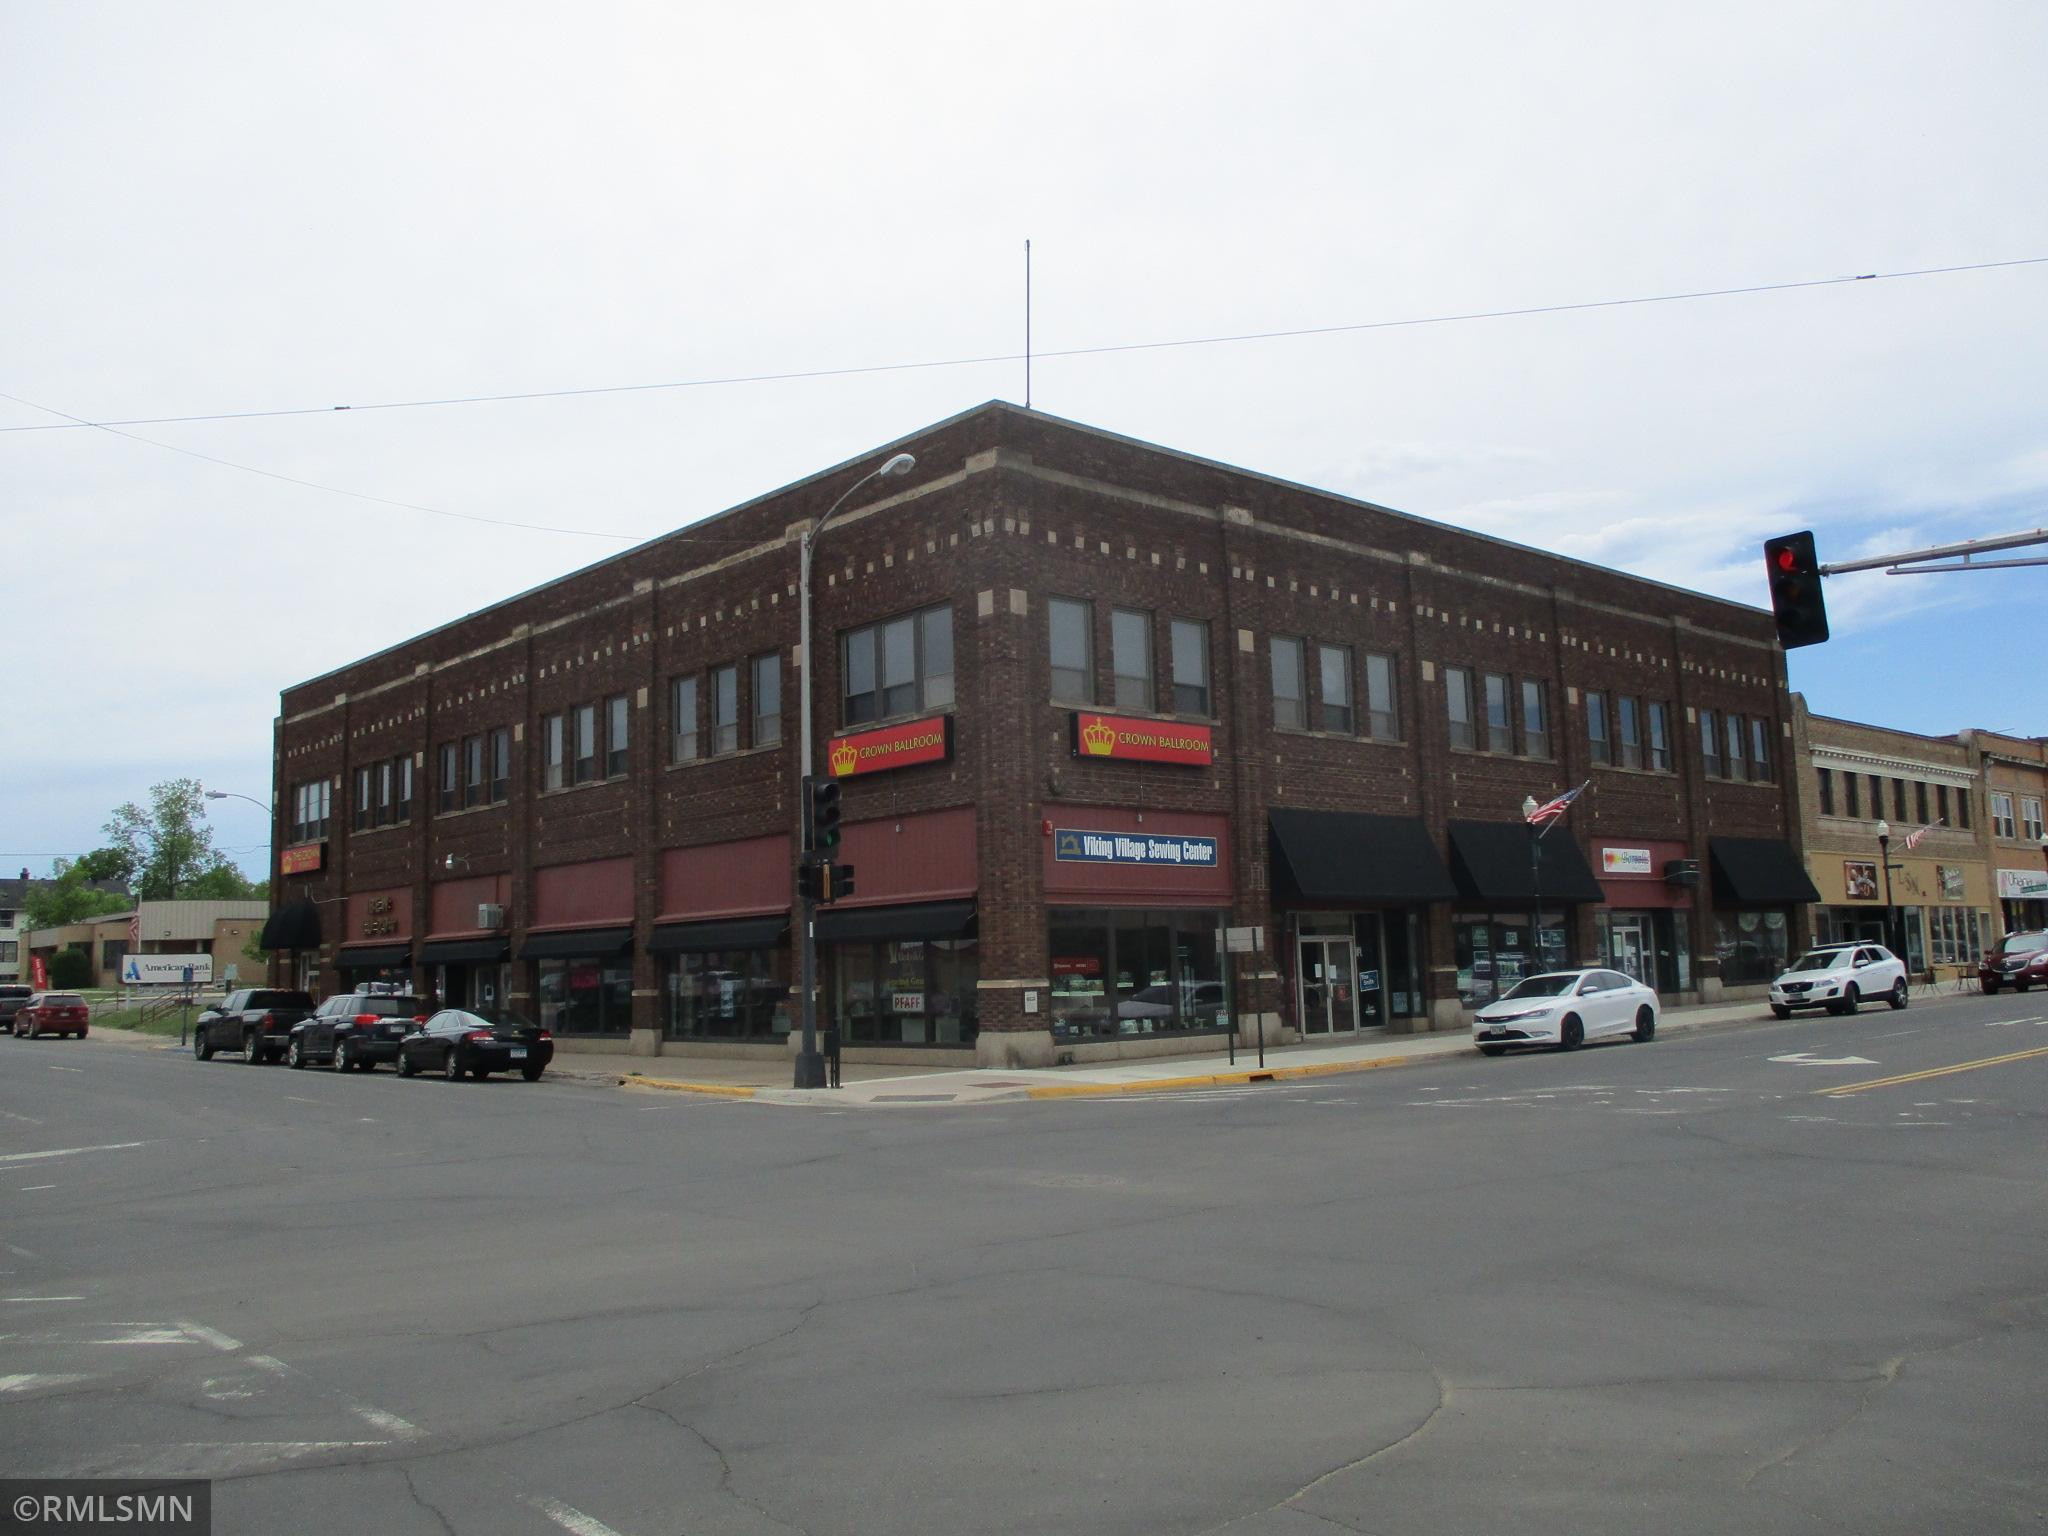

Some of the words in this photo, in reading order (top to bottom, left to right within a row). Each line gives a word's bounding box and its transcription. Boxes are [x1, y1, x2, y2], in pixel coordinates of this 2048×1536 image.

[859, 743, 893, 759] CROWN
[894, 733, 942, 752] BALLROOM
[1119, 732, 1157, 747] CROWN
[1159, 736, 1209, 752] BALLROOM
[1083, 835, 1113, 860] Viking
[1114, 837, 1146, 862] Village
[1148, 839, 1181, 862] Sewing
[1182, 841, 1213, 861] Center
[144, 963, 185, 972] American
[895, 996, 921, 1009] PFAFF
